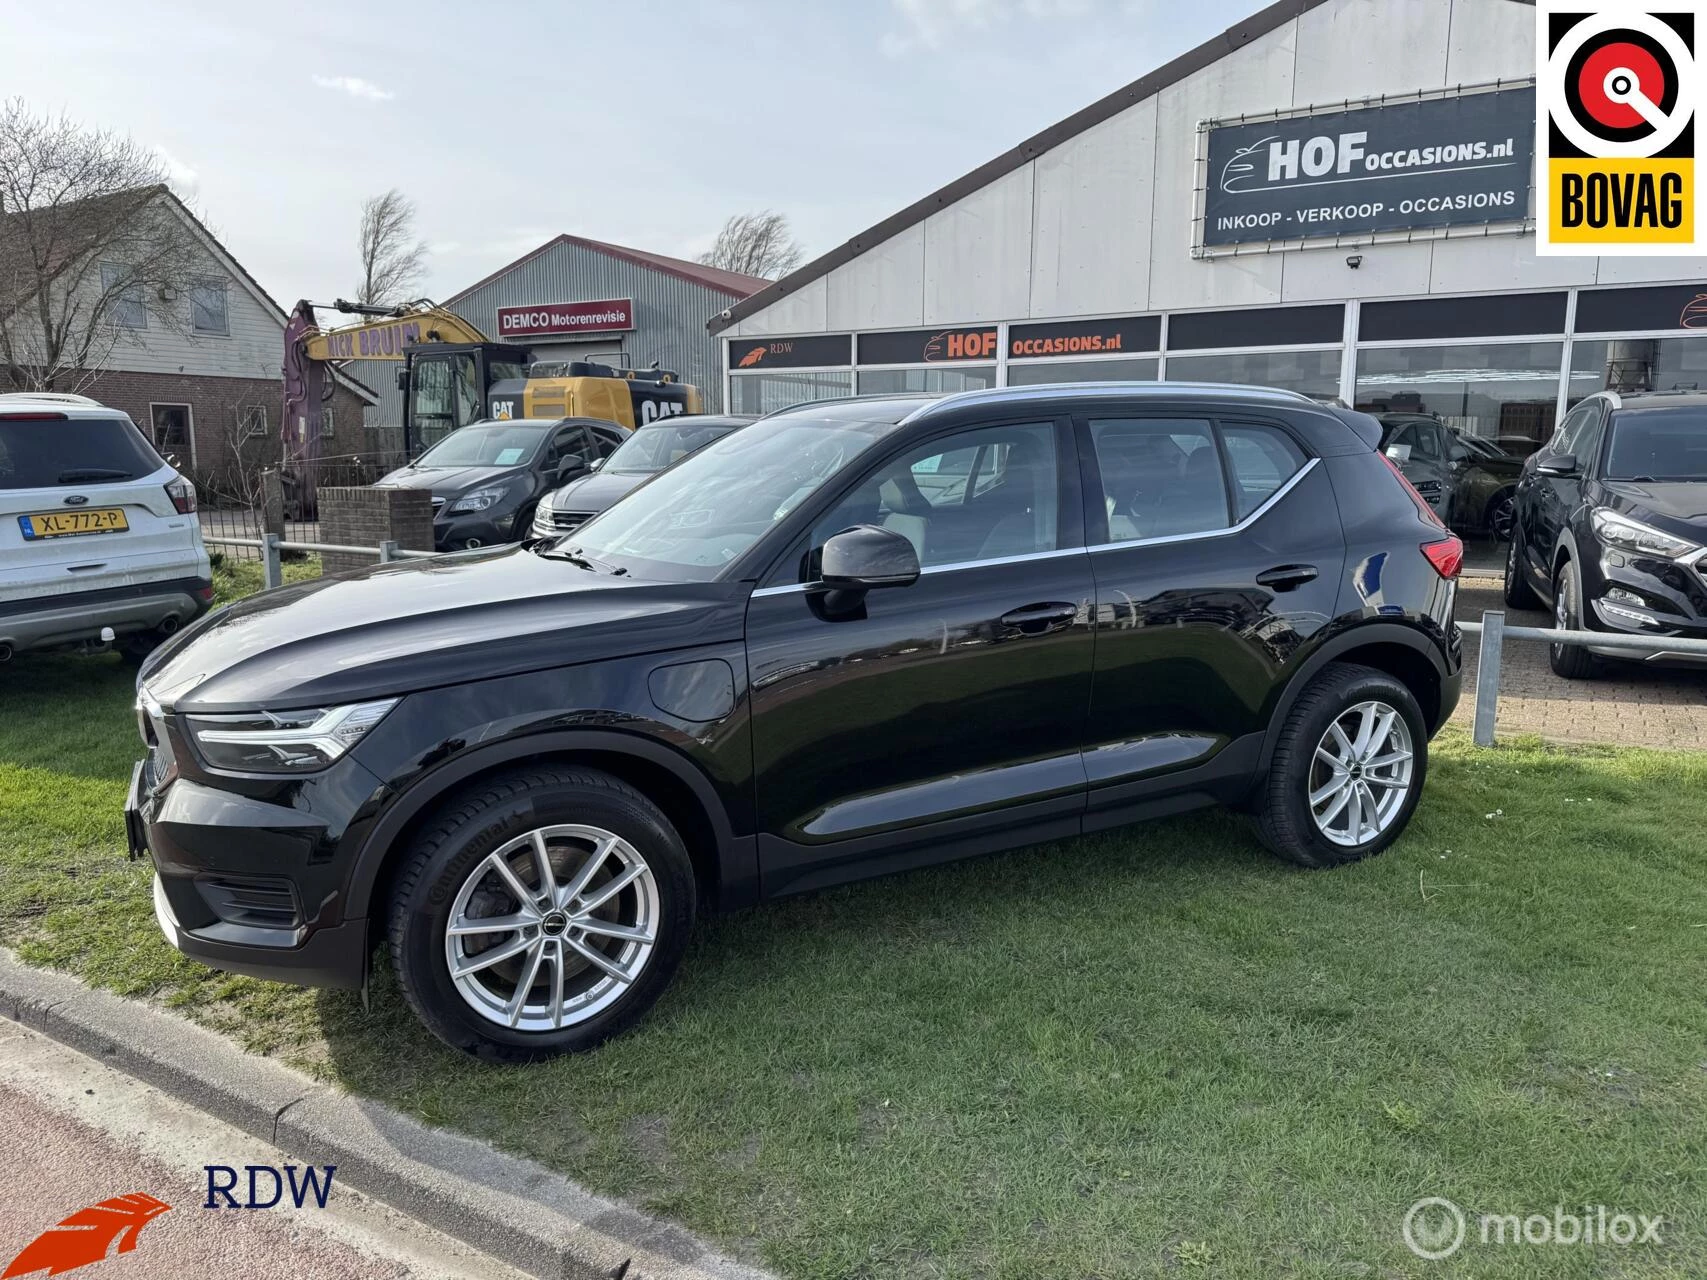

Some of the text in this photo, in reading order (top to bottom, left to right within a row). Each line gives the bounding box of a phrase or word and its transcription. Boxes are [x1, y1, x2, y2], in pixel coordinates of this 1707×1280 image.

[1217, 212, 1282, 231] INKOOP
[1296, 203, 1384, 224] VERKOOP
[1400, 190, 1515, 214] OCCASIONS
[503, 310, 626, 329] DEMCO Motorenrevisie
[770, 342, 793, 354] RDW
[947, 332, 1122, 357] HOF OCCASIONS.nl
[492, 401, 514, 420] CAT
[40, 512, 118, 532] XL-772-P
